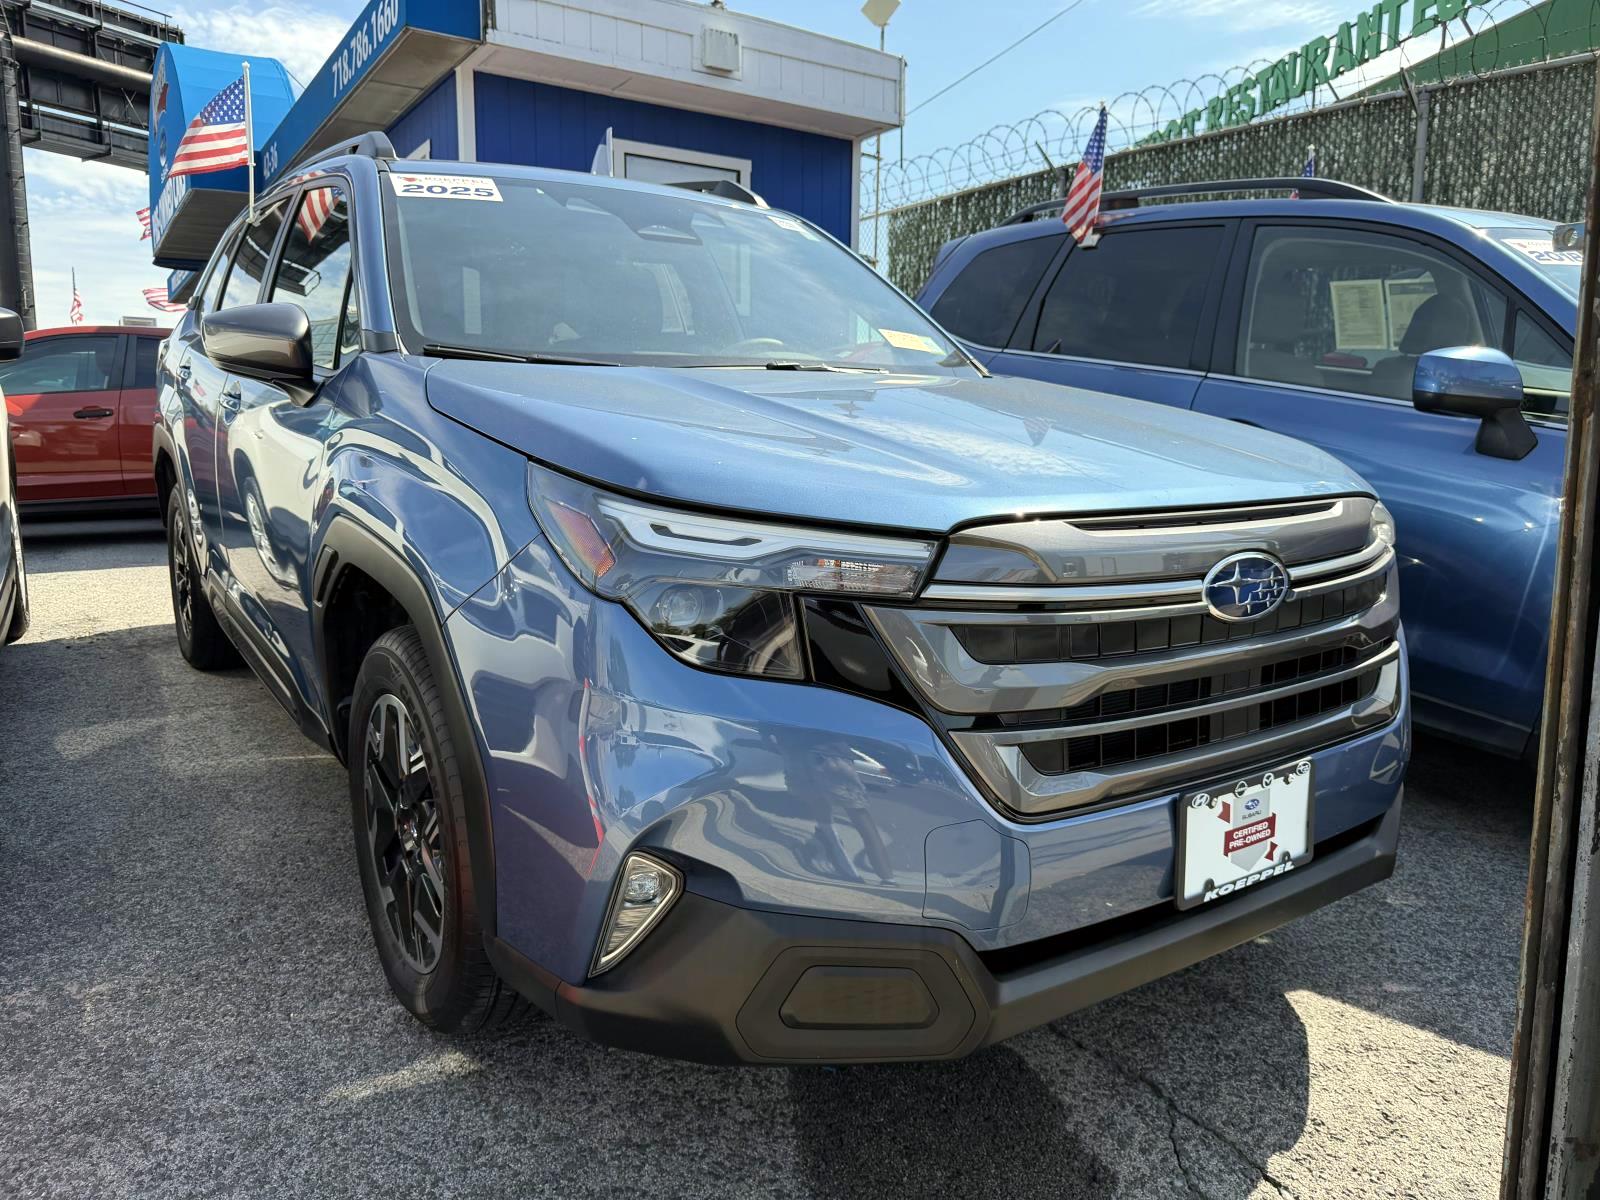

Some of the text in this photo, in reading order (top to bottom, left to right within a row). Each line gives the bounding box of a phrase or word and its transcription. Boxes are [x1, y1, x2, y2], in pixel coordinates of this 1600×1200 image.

[332, 0, 399, 98] 718.786.1660
[1207, 0, 1409, 132] RESTAURANT
[402, 184, 494, 197] 2025
[1241, 809, 1262, 820] SUBARU
[1229, 829, 1271, 849] PRE-OWNED
[1233, 821, 1268, 839] CERTIFIED
[1204, 861, 1295, 902] KOEPPEL
